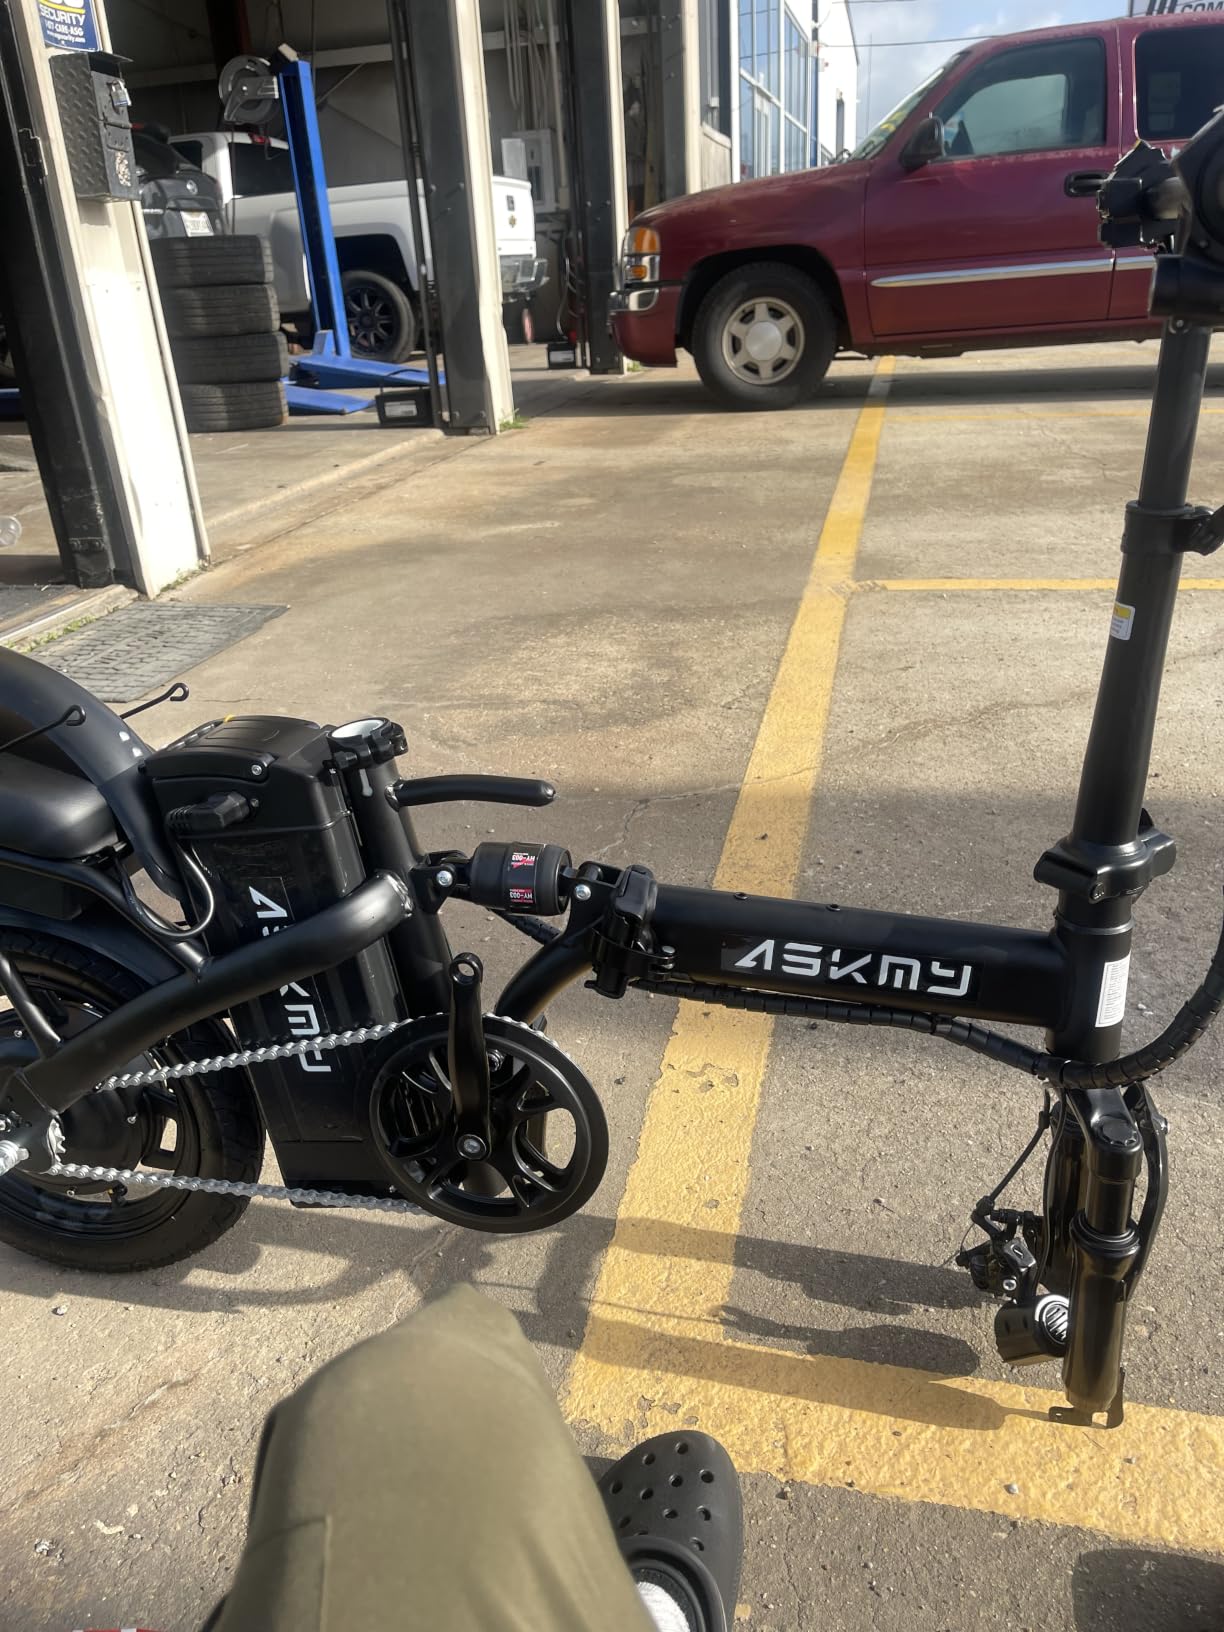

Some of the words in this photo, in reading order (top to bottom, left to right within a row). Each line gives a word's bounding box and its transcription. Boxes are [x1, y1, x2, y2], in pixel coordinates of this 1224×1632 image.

[39, 4, 86, 26] SECURITY
[249, 886, 332, 1072] AMY
[734, 939, 972, 997] ASKMY
